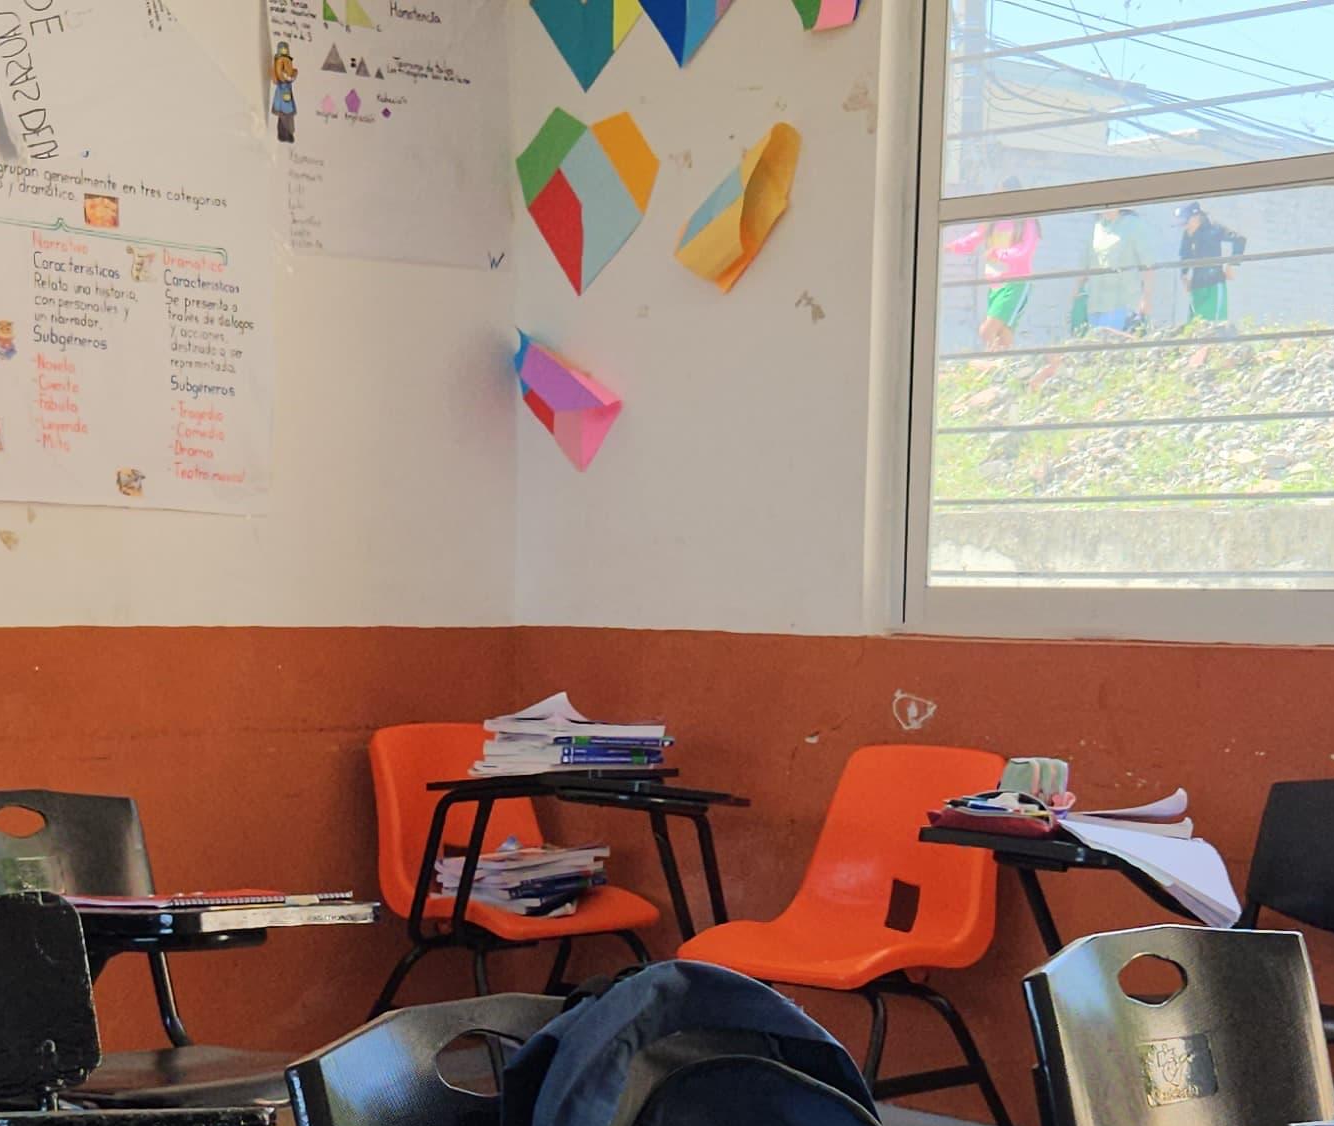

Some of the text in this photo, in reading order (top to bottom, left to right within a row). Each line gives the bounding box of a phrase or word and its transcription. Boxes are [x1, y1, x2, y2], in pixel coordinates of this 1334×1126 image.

[44, 167, 117, 191] generalmente
[123, 183, 137, 194] en
[141, 180, 162, 199] tres
[34, 271, 68, 292] Relata
[74, 284, 91, 296] una
[34, 295, 55, 306] con
[165, 289, 179, 303] Se
[34, 313, 46, 322] un
